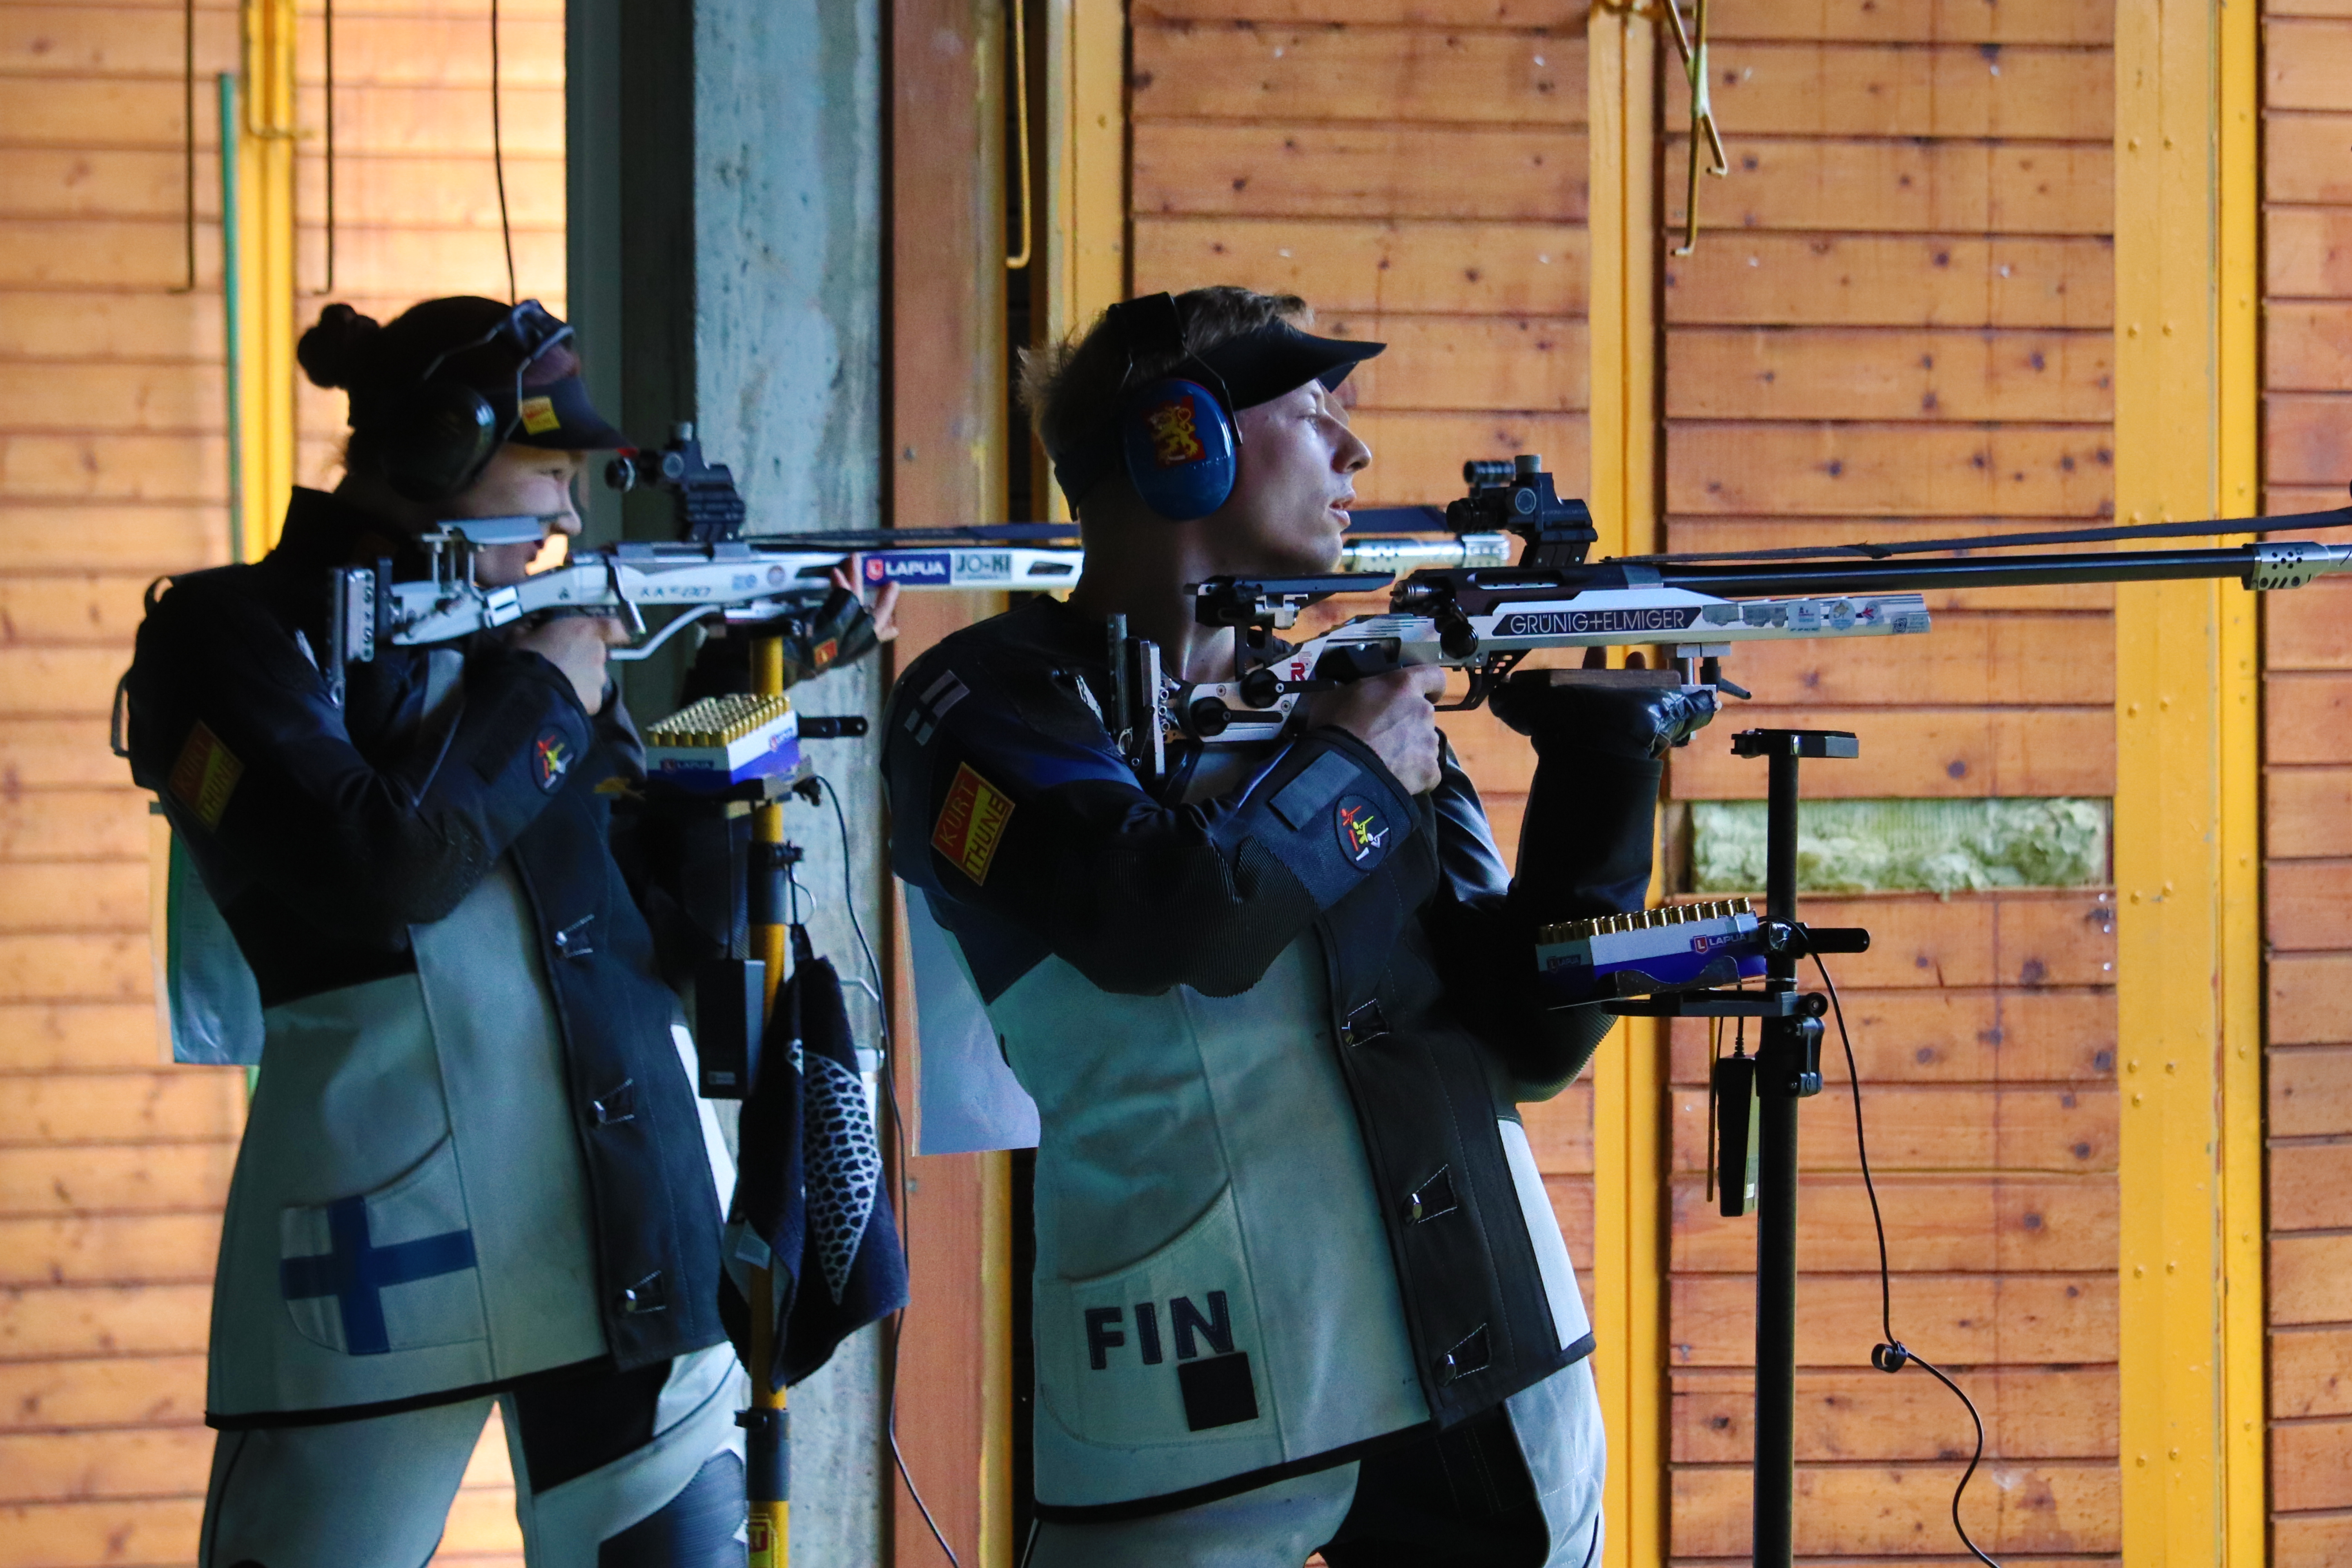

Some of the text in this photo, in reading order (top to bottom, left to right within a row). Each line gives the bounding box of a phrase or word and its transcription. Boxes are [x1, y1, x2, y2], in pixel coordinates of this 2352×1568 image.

[885, 561, 946, 575] LAPUA
[1510, 610, 1684, 634] GRÜNIG+ELMIGER
[939, 779, 975, 846] KURT
[965, 793, 1006, 869] THUNE
[1709, 934, 1747, 946] LAPUA
[1085, 1290, 1234, 1370] FIN
